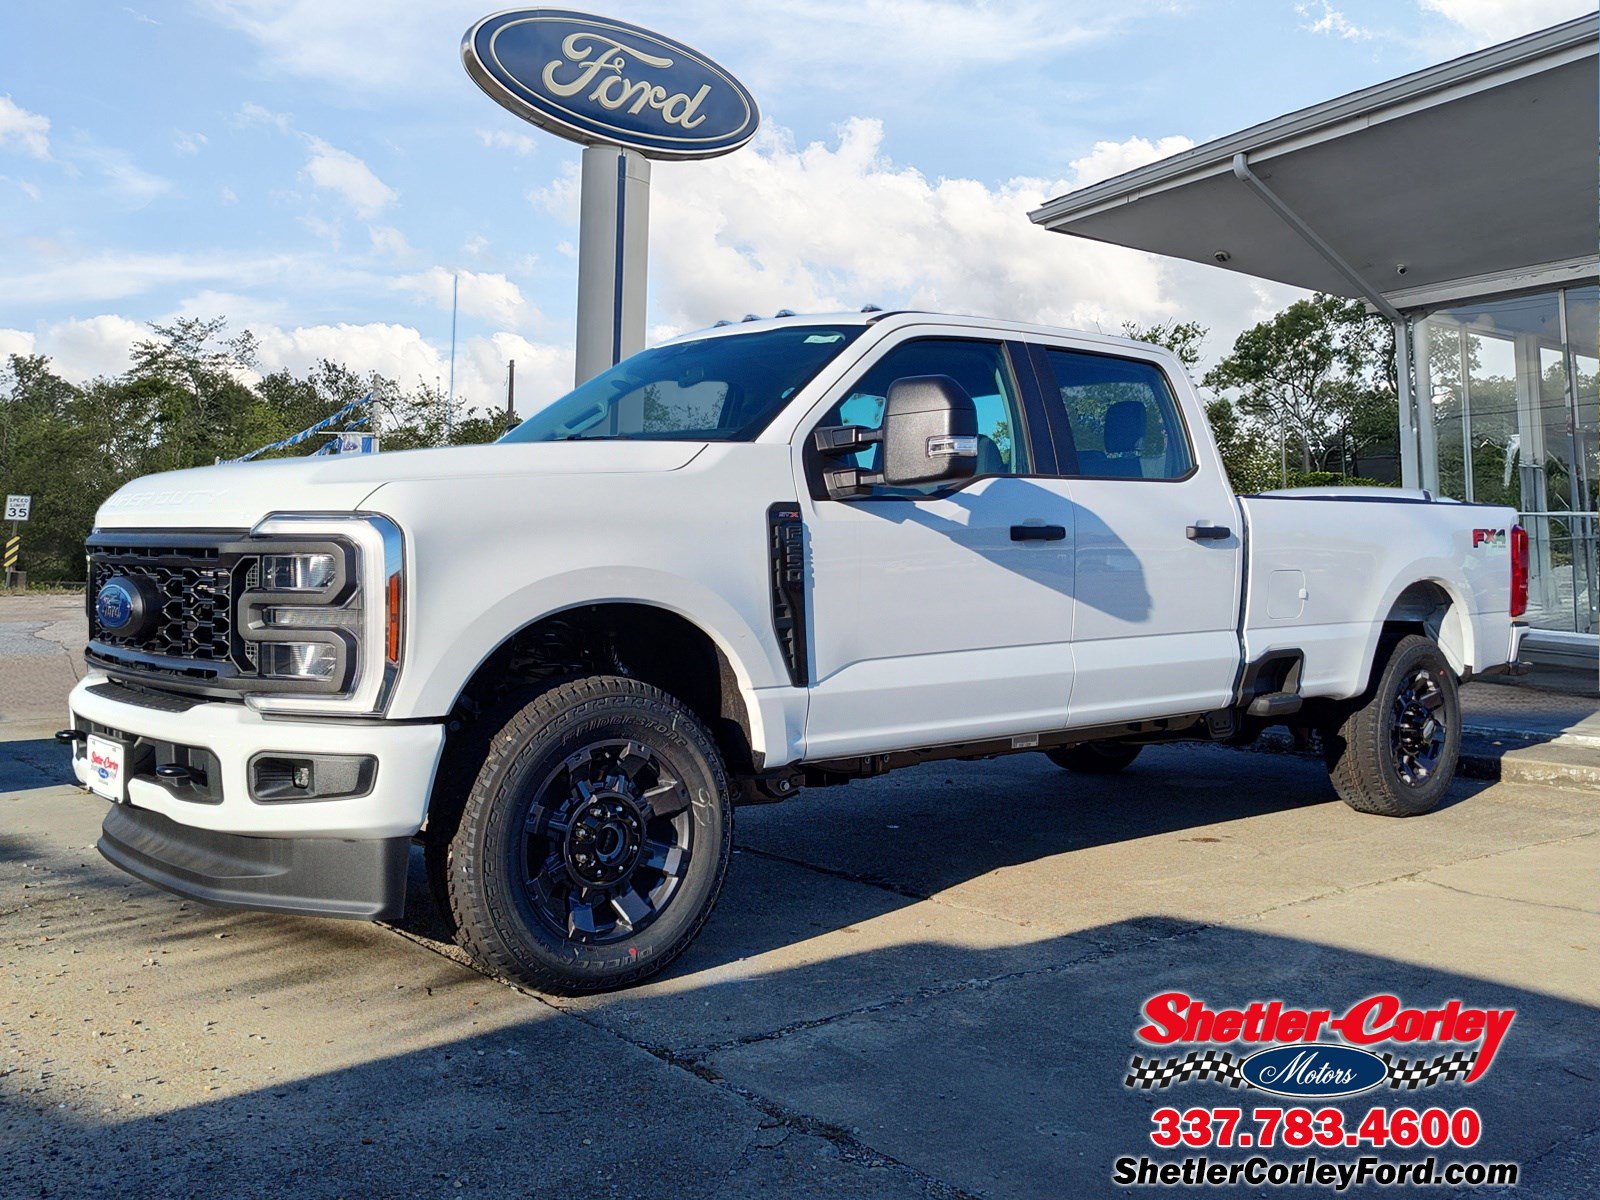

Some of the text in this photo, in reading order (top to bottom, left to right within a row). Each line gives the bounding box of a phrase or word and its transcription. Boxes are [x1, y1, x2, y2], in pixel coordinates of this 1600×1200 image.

[542, 32, 712, 129] Ford
[8, 507, 27, 518] 35
[1472, 528, 1506, 549] FX4
